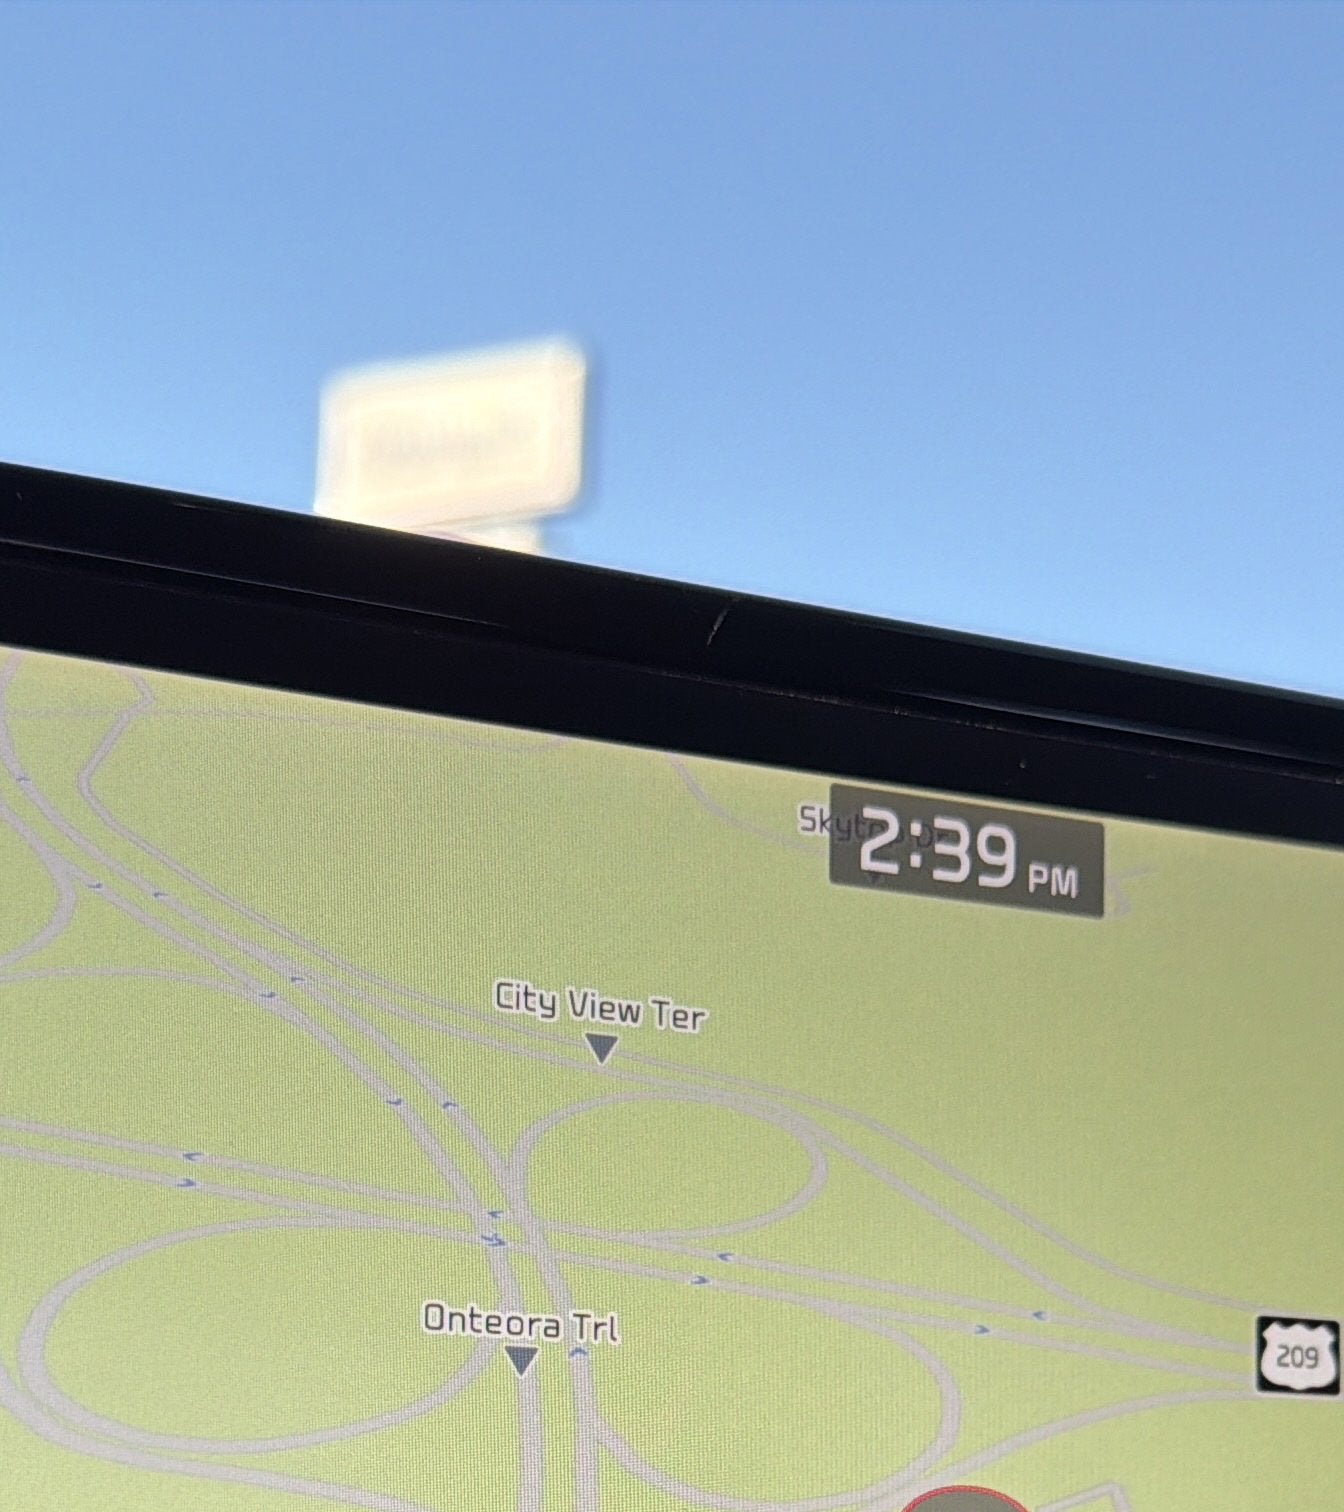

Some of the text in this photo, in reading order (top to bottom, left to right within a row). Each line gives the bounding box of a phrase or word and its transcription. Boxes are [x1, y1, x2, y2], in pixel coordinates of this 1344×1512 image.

[801, 806, 905, 848] Skyt
[860, 806, 1078, 899] 2:39 PM
[496, 982, 706, 1030] City View Ter
[424, 1303, 618, 1342] Onteora Trl
[1277, 1344, 1318, 1369] 209
